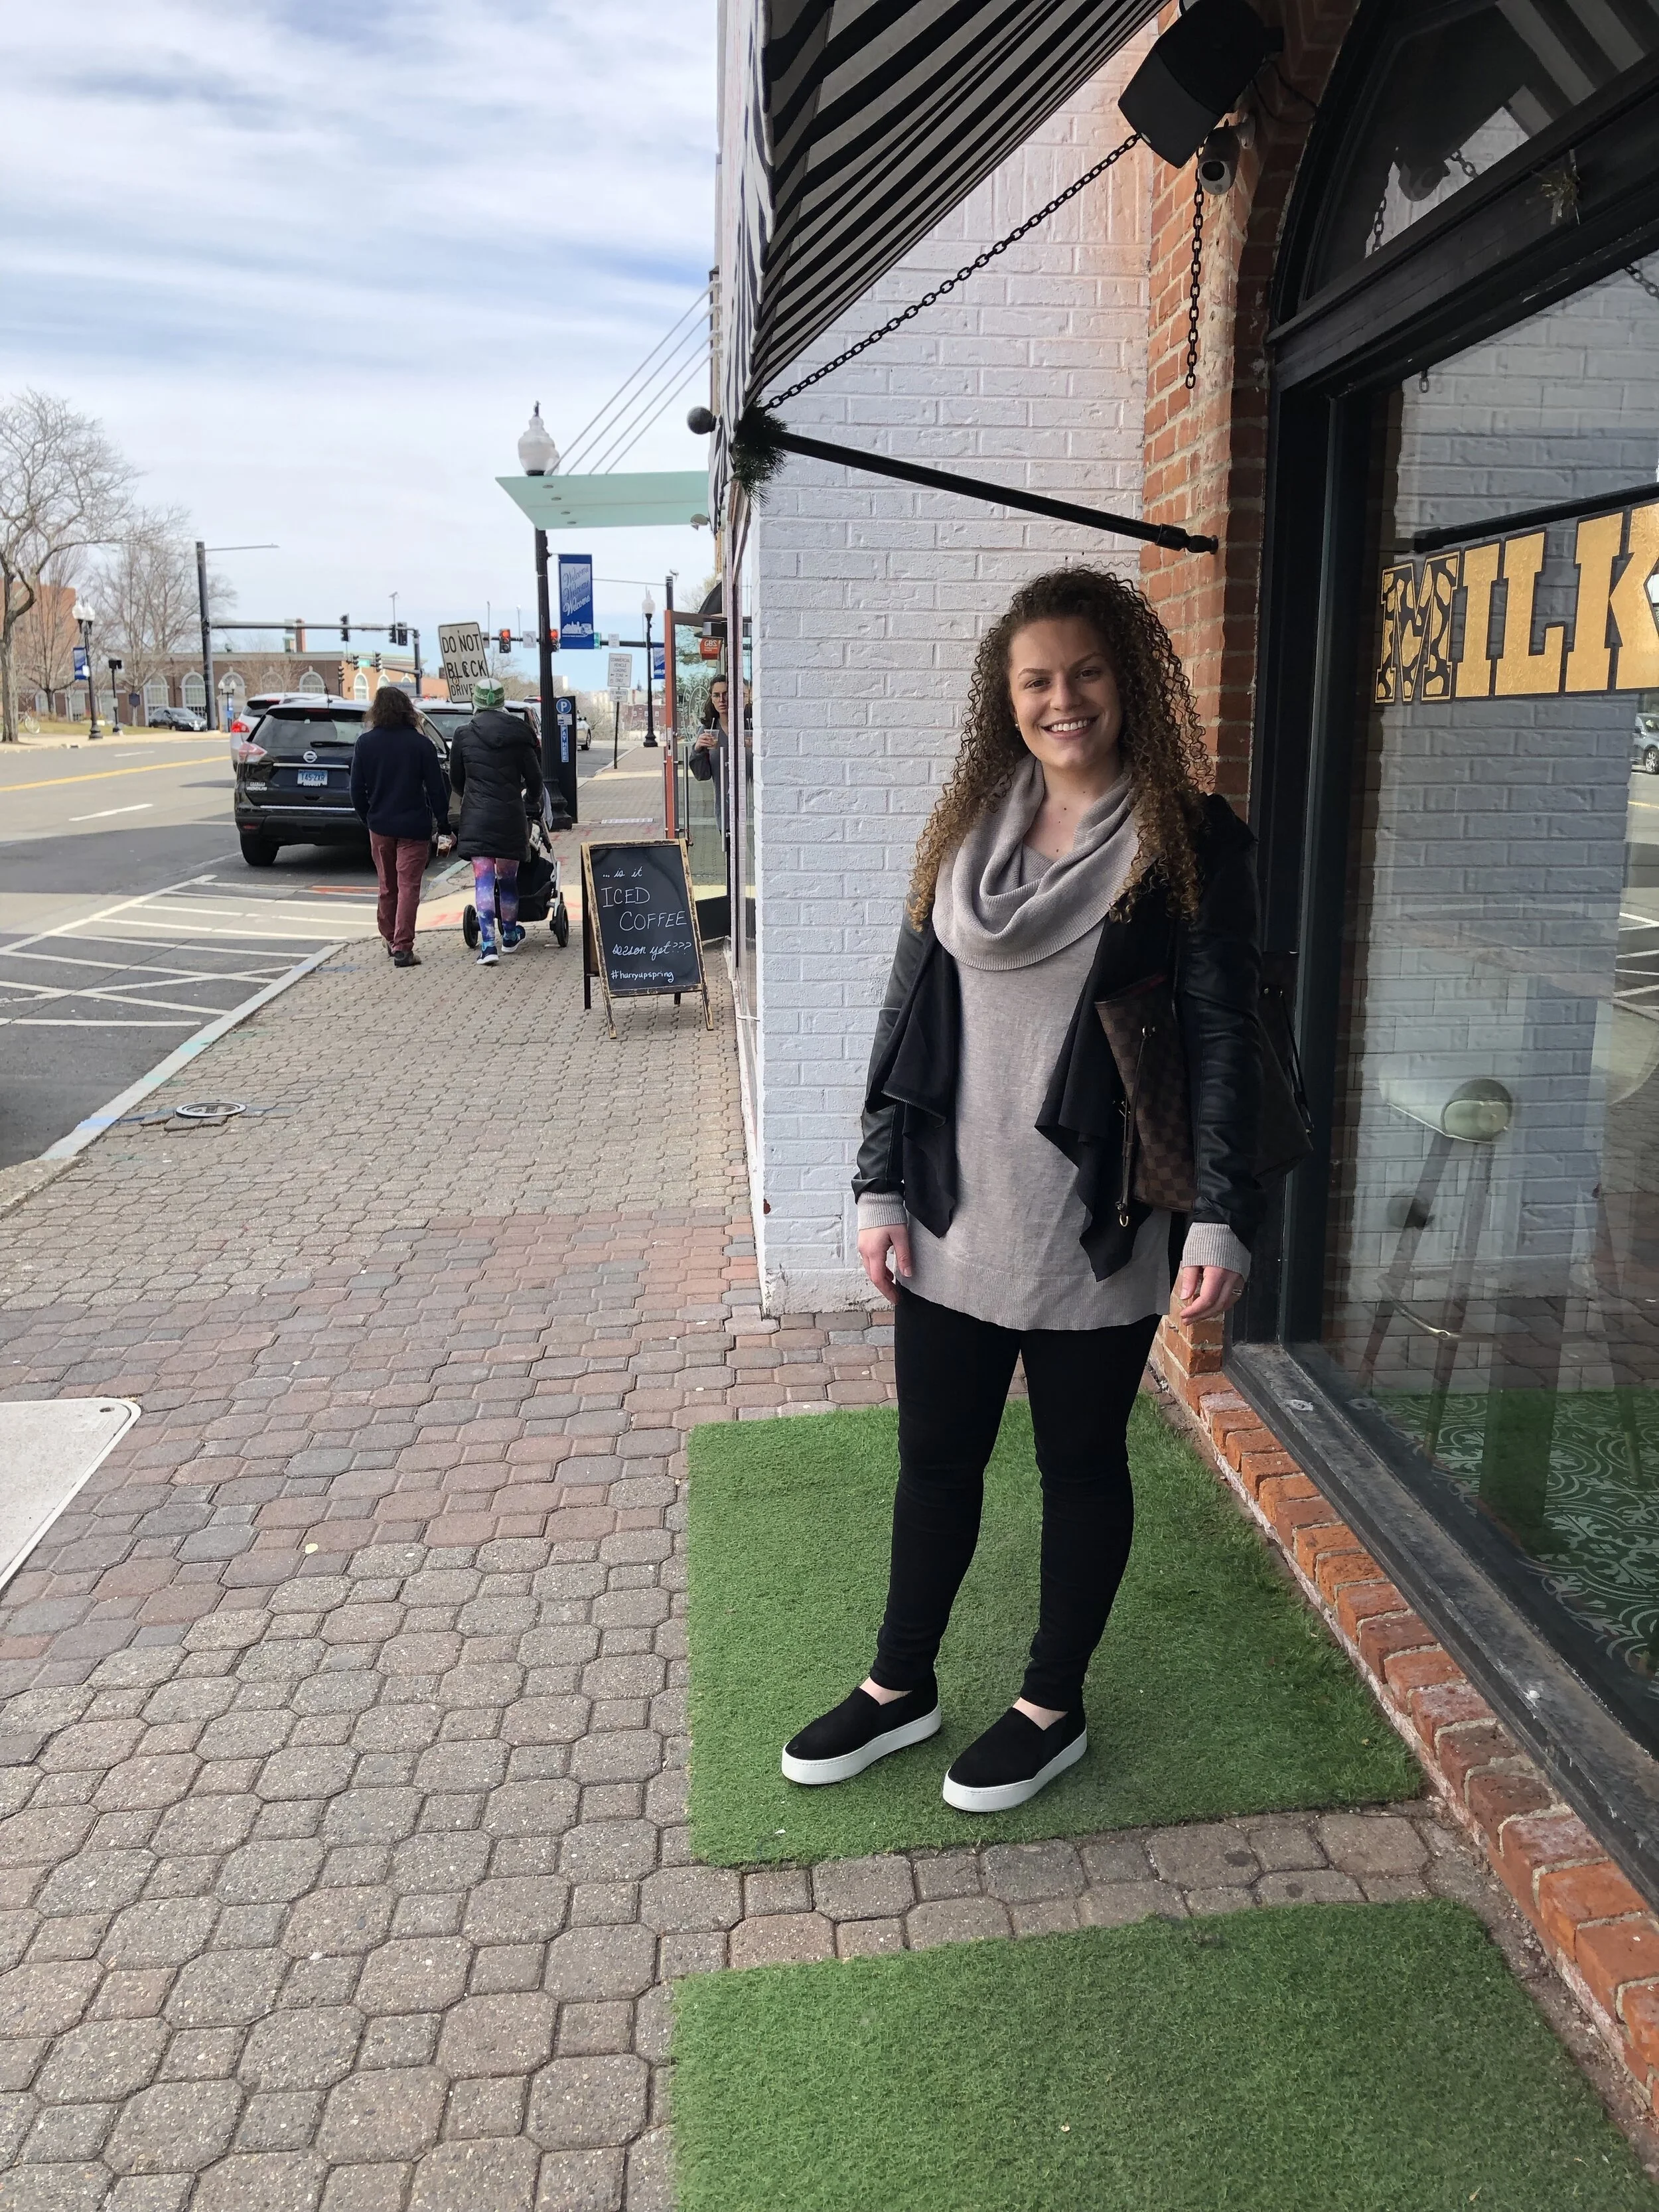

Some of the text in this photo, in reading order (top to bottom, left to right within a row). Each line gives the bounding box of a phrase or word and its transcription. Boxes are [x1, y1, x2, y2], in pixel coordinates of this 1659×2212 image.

[563, 566, 589, 586] Welcome
[563, 580, 589, 600] Welcome
[562, 595, 591, 617] Welcome
[1374, 500, 1659, 705] MILK
[441, 634, 479, 653] DO NOT
[447, 660, 487, 678] BLOCK
[451, 684, 475, 696] DRIVE
[560, 701, 567, 711] P
[613, 867, 625, 878] is
[631, 865, 643, 877] it
[601, 887, 650, 908] ICED
[619, 911, 687, 931] COFFEE
[612, 940, 692, 961] season yet???
[611, 969, 674, 983] #hurryupspring
